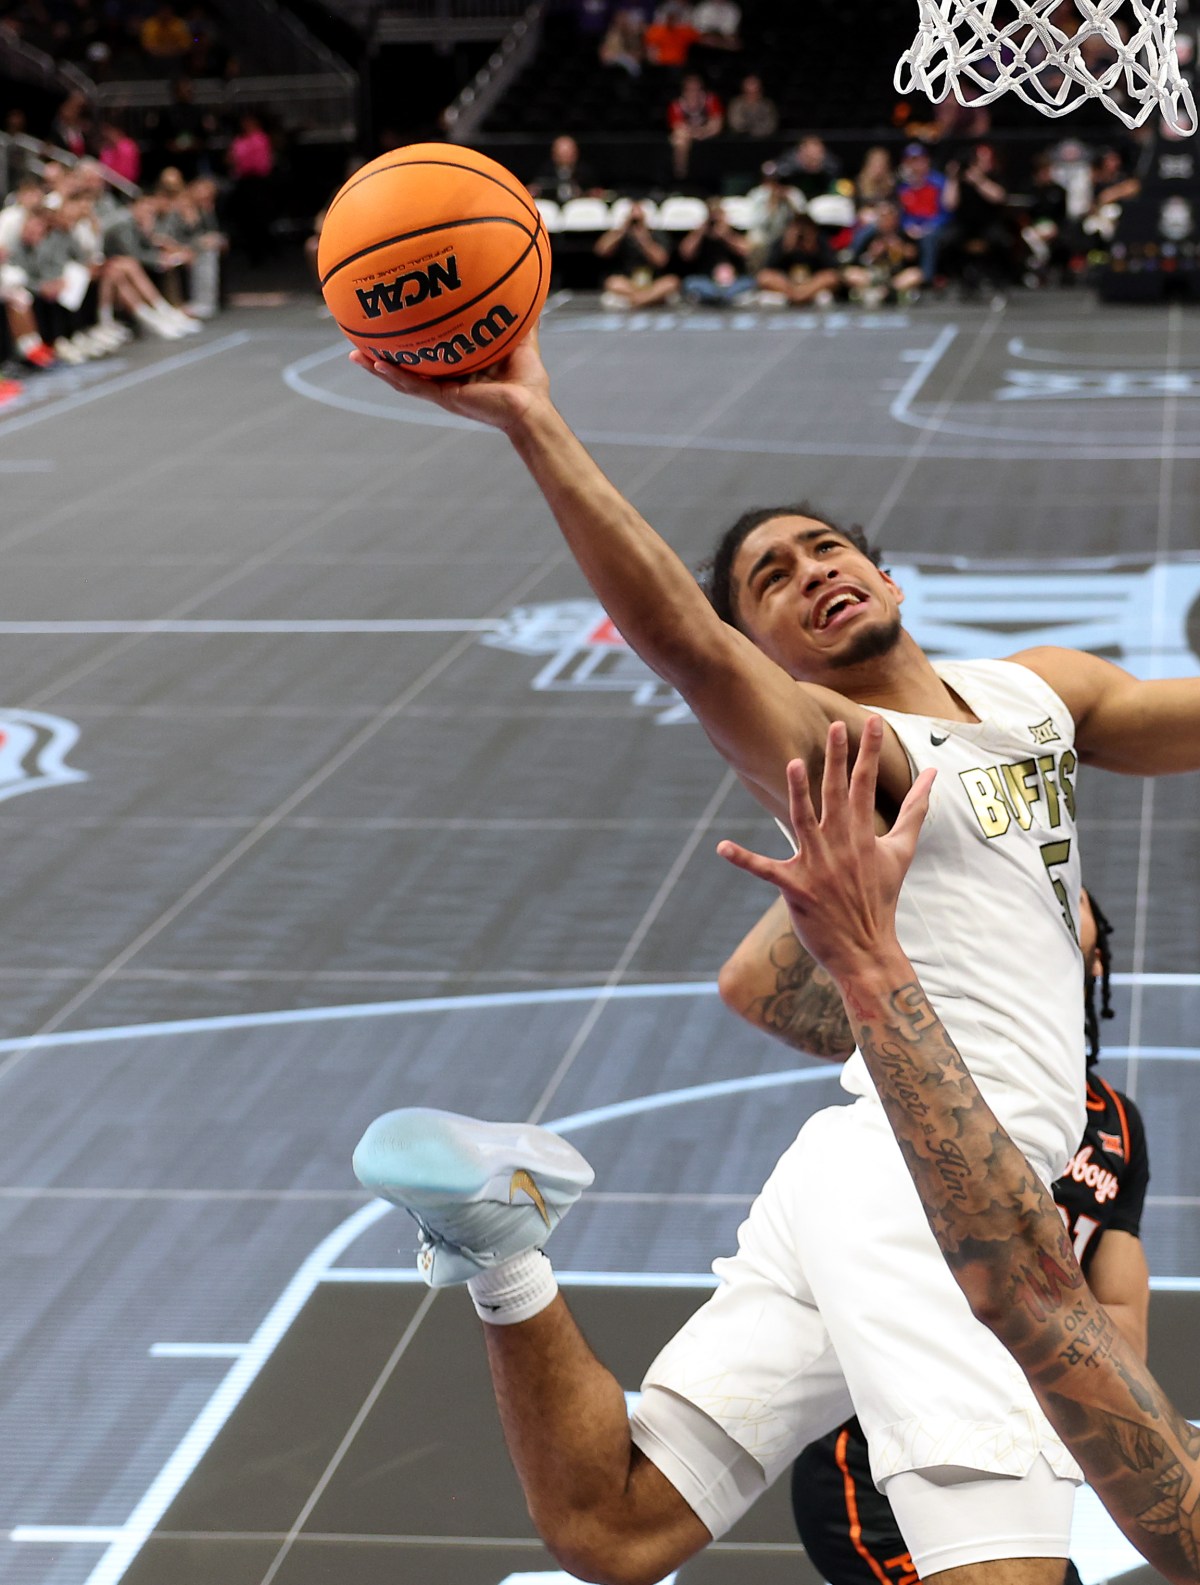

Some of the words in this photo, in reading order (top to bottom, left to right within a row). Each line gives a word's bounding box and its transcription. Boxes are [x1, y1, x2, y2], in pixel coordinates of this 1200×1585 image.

[352, 274, 375, 284] BALL
[377, 264, 406, 277] GAME
[407, 245, 454, 266] OFFICIAL
[355, 254, 462, 319] NCAA
[367, 304, 519, 365] Wilson
[959, 750, 1077, 839] BUFFS
[877, 1041, 930, 1118] Trust
[926, 1138, 972, 1201] Him
[1063, 1145, 1120, 1204] boys
